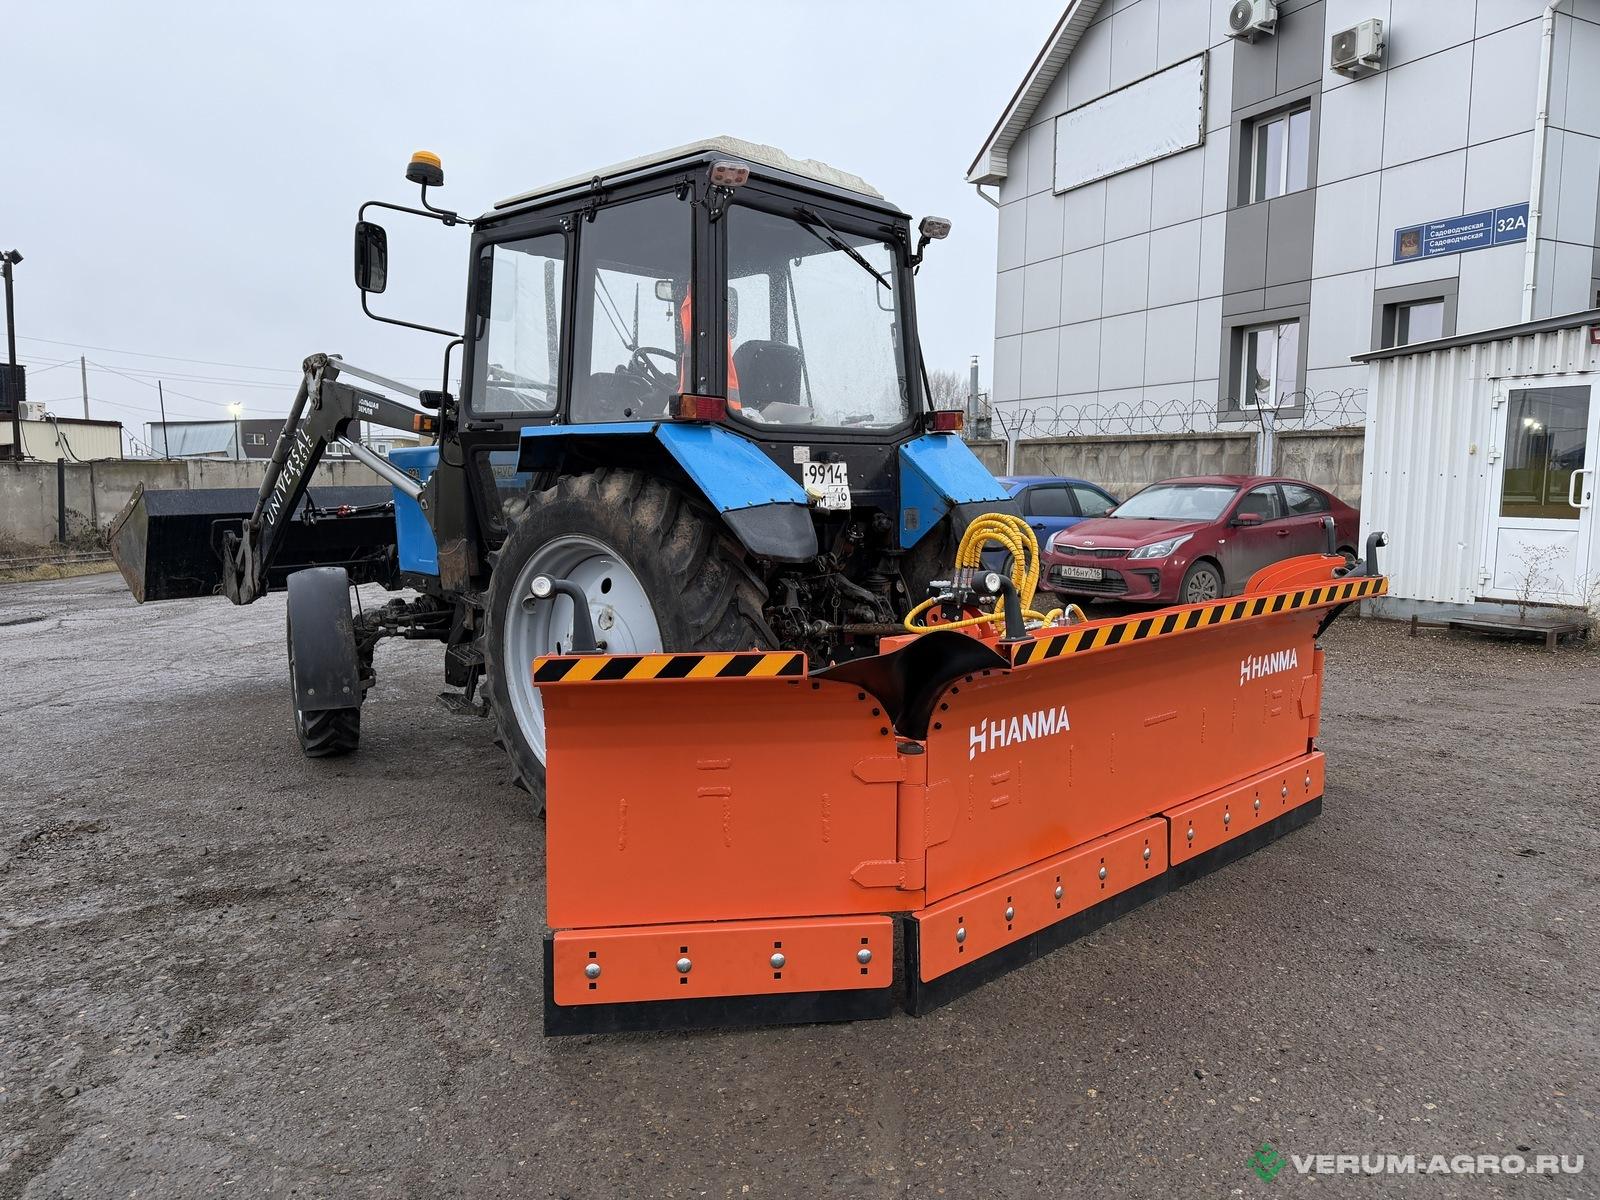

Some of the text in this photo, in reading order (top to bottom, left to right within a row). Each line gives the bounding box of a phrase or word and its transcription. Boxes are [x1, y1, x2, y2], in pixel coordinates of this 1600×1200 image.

[1429, 232, 1484, 247] Садоводческая
[1430, 222, 1485, 238] Садоводческая
[296, 438, 314, 477] BASIC
[266, 428, 310, 526] UNIVERSAL
[808, 464, 843, 484] 9914
[1252, 647, 1298, 679] HANMA
[990, 705, 1071, 750] HANMA
